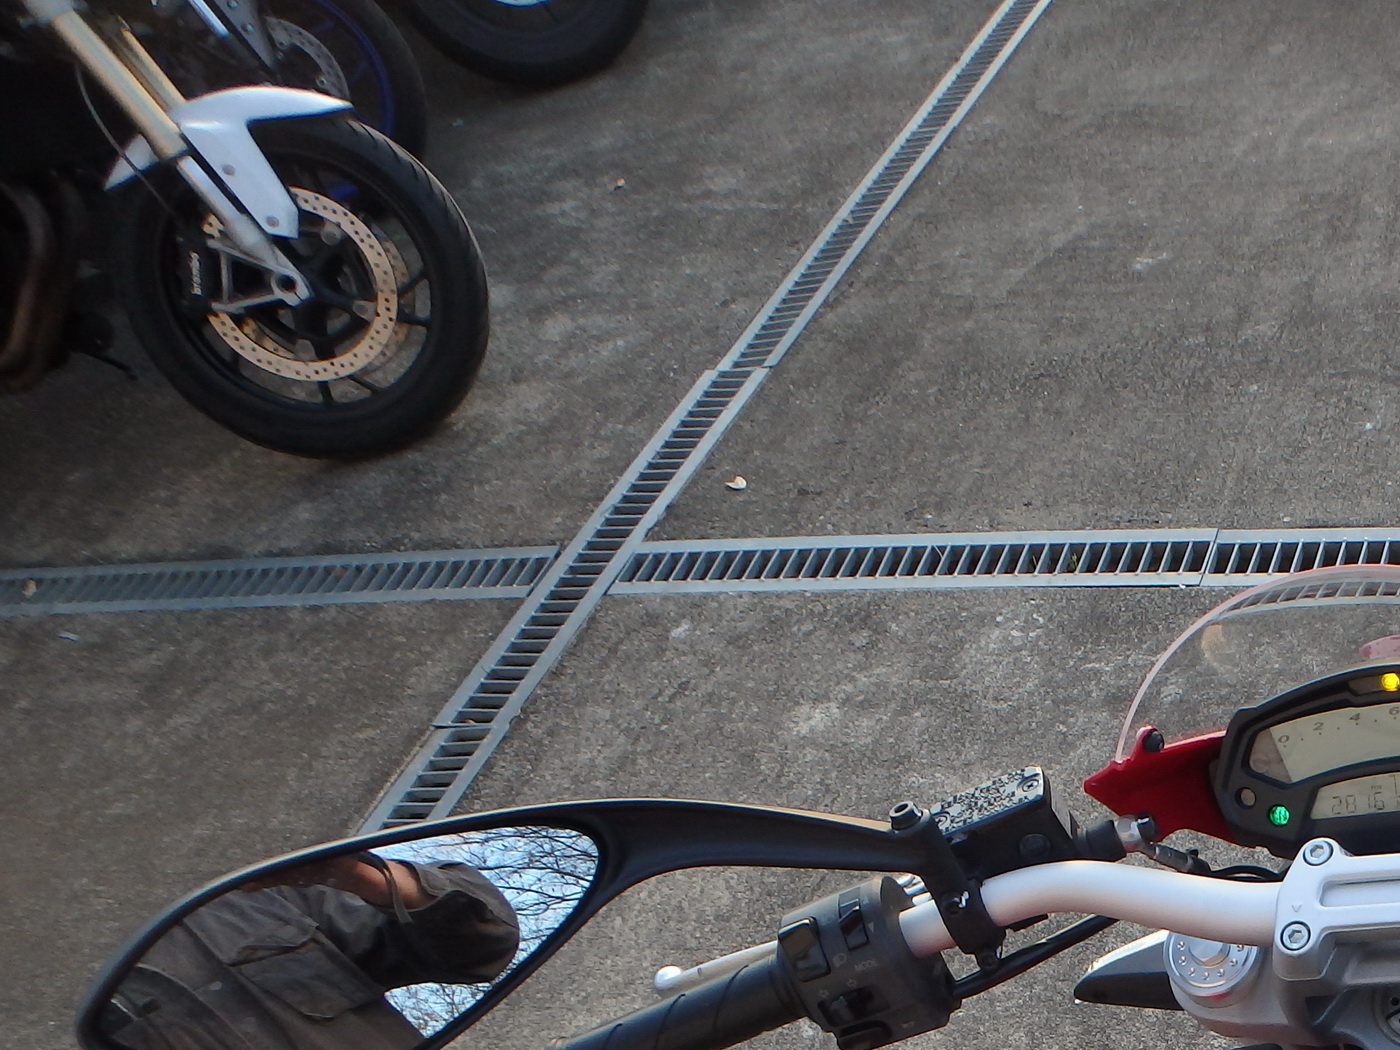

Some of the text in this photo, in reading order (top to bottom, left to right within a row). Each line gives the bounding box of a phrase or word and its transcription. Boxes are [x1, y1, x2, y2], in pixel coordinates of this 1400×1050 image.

[1313, 722, 1324, 731] 2
[1349, 713, 1361, 722] 4
[1388, 706, 1400, 716] 6
